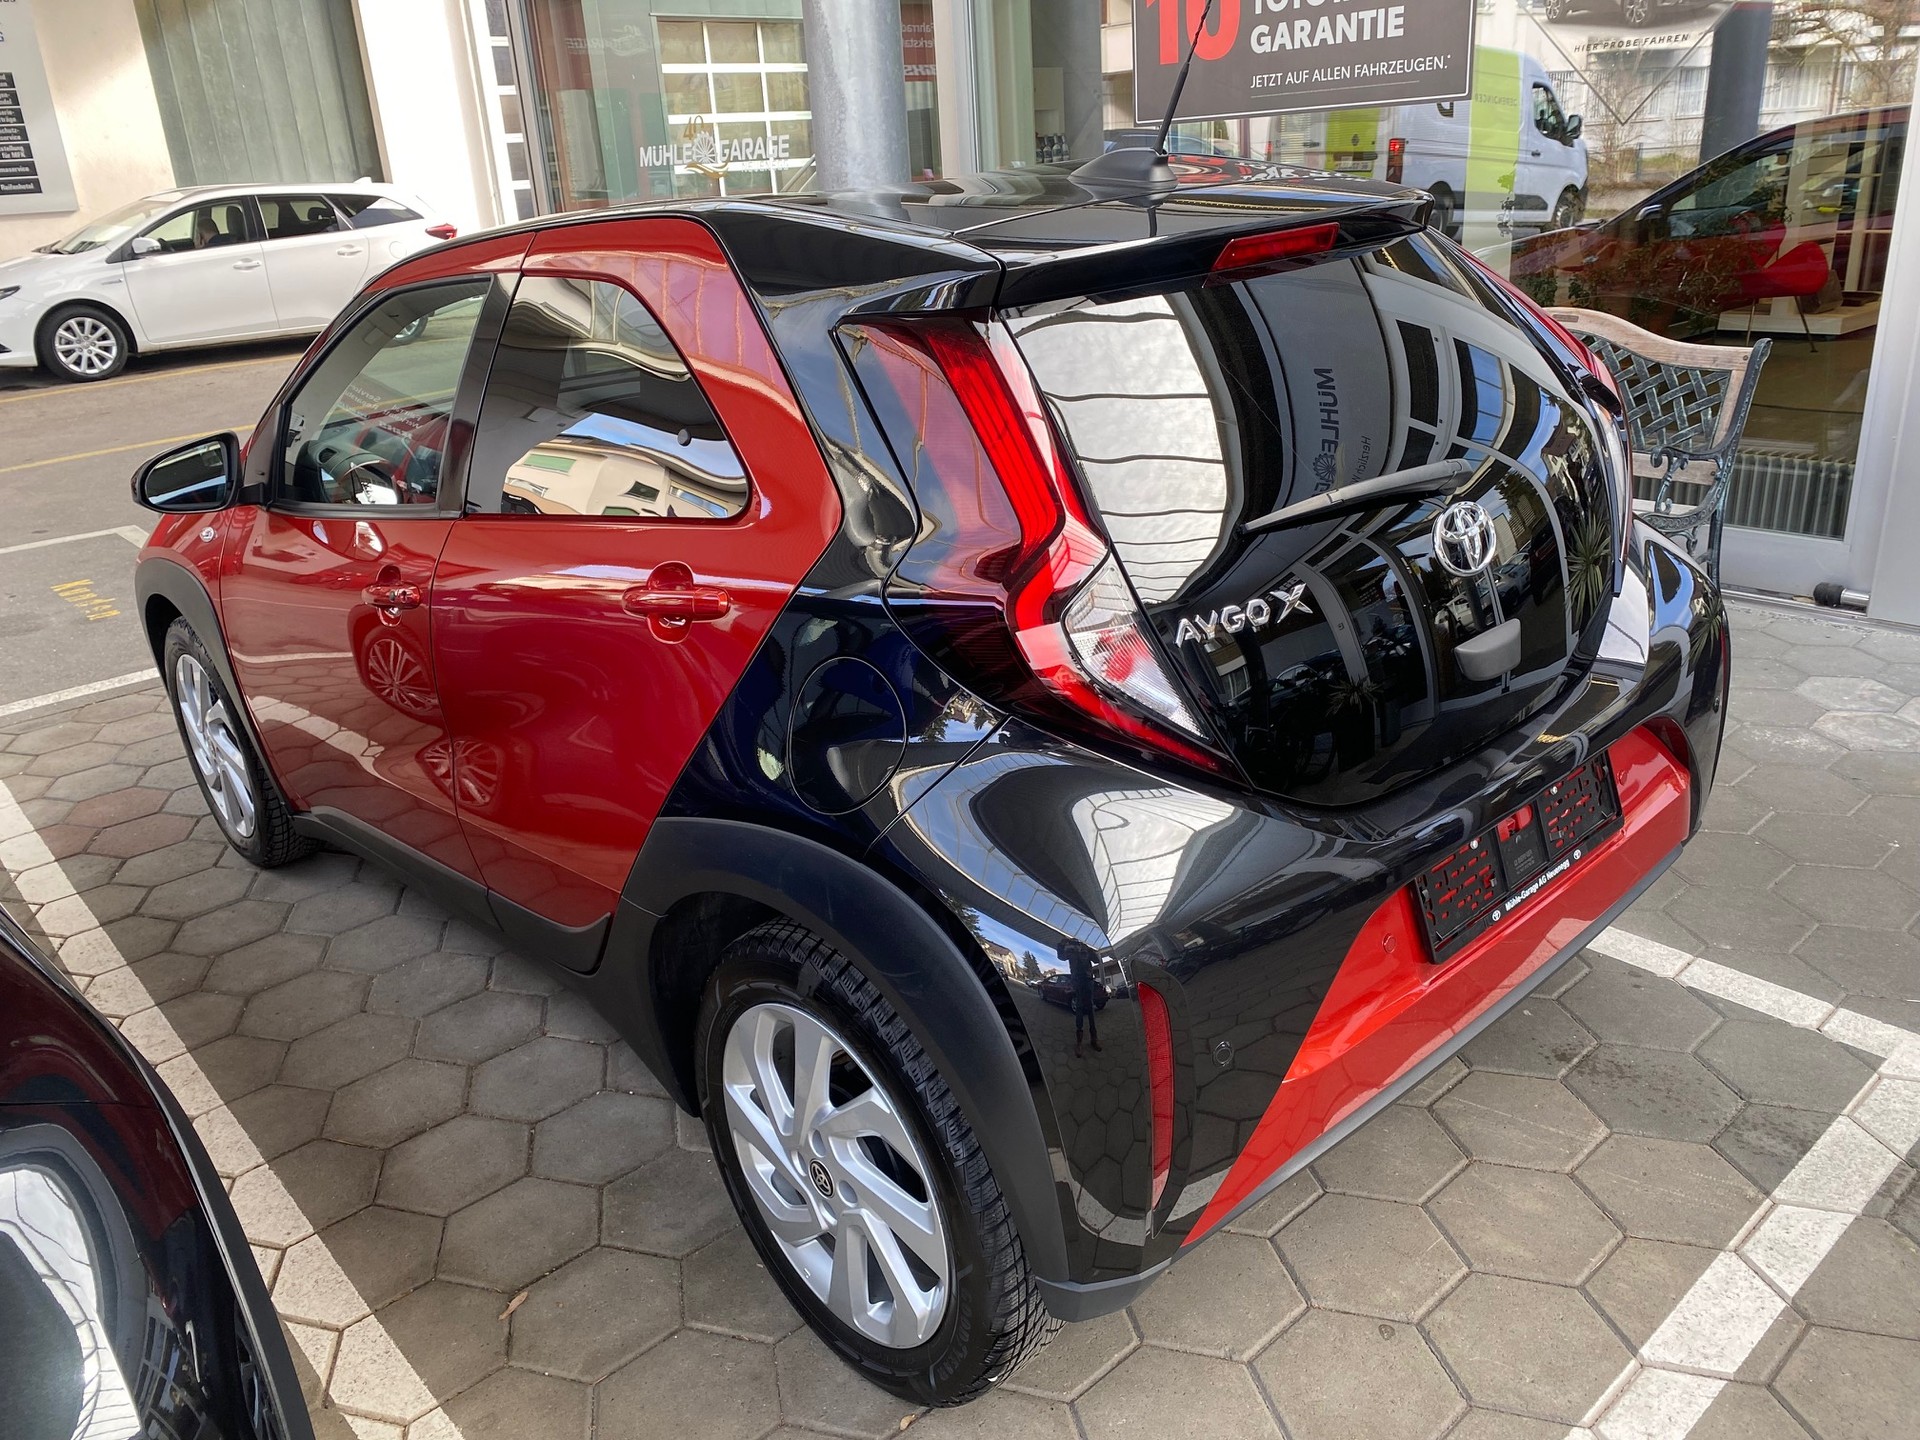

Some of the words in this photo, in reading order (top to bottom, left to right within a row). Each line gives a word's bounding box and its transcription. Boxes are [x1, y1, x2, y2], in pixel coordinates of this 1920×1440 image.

[1250, 5, 1405, 54] GARANTIE
[1574, 42, 1599, 53] HIER
[1250, 72, 1283, 89] JETZT
[1285, 70, 1310, 85] AUF
[1312, 65, 1351, 82] ALLEN
[639, 142, 693, 168] MÜHLE
[719, 134, 790, 162] GARAGE
[1174, 598, 1271, 649] AYGO
[1269, 582, 1314, 624] X
